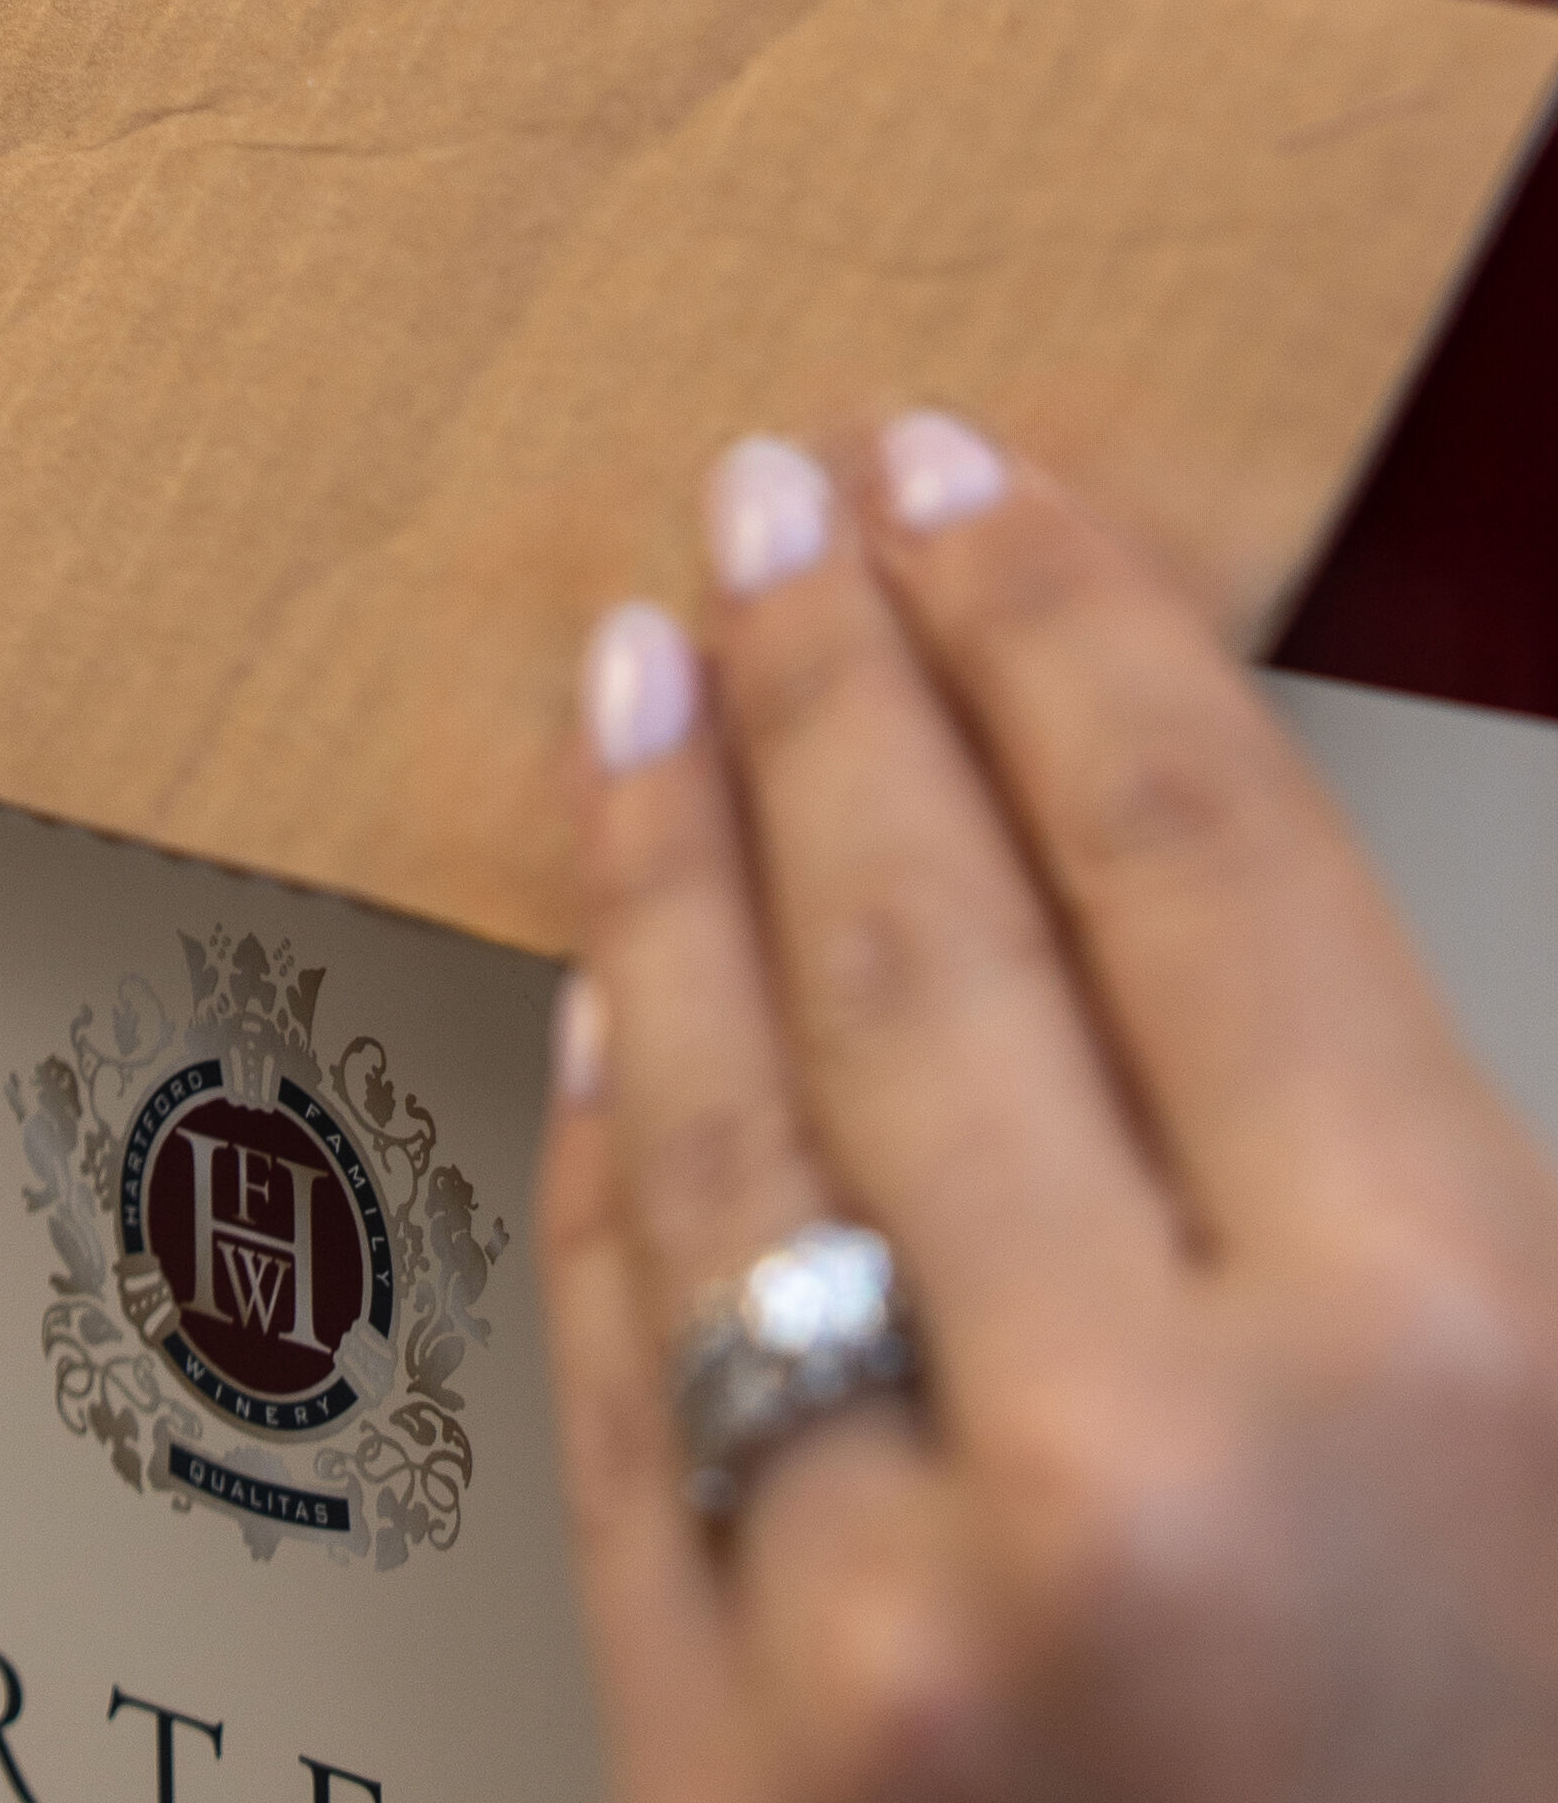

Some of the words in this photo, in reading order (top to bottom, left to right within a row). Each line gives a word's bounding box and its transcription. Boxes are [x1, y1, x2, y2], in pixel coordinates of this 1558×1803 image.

[122, 1069, 204, 1228] HARTFORD
[304, 1102, 391, 1289] FAMILY
[185, 1351, 330, 1427] WINERY
[188, 1457, 330, 1527] QUALITAS
